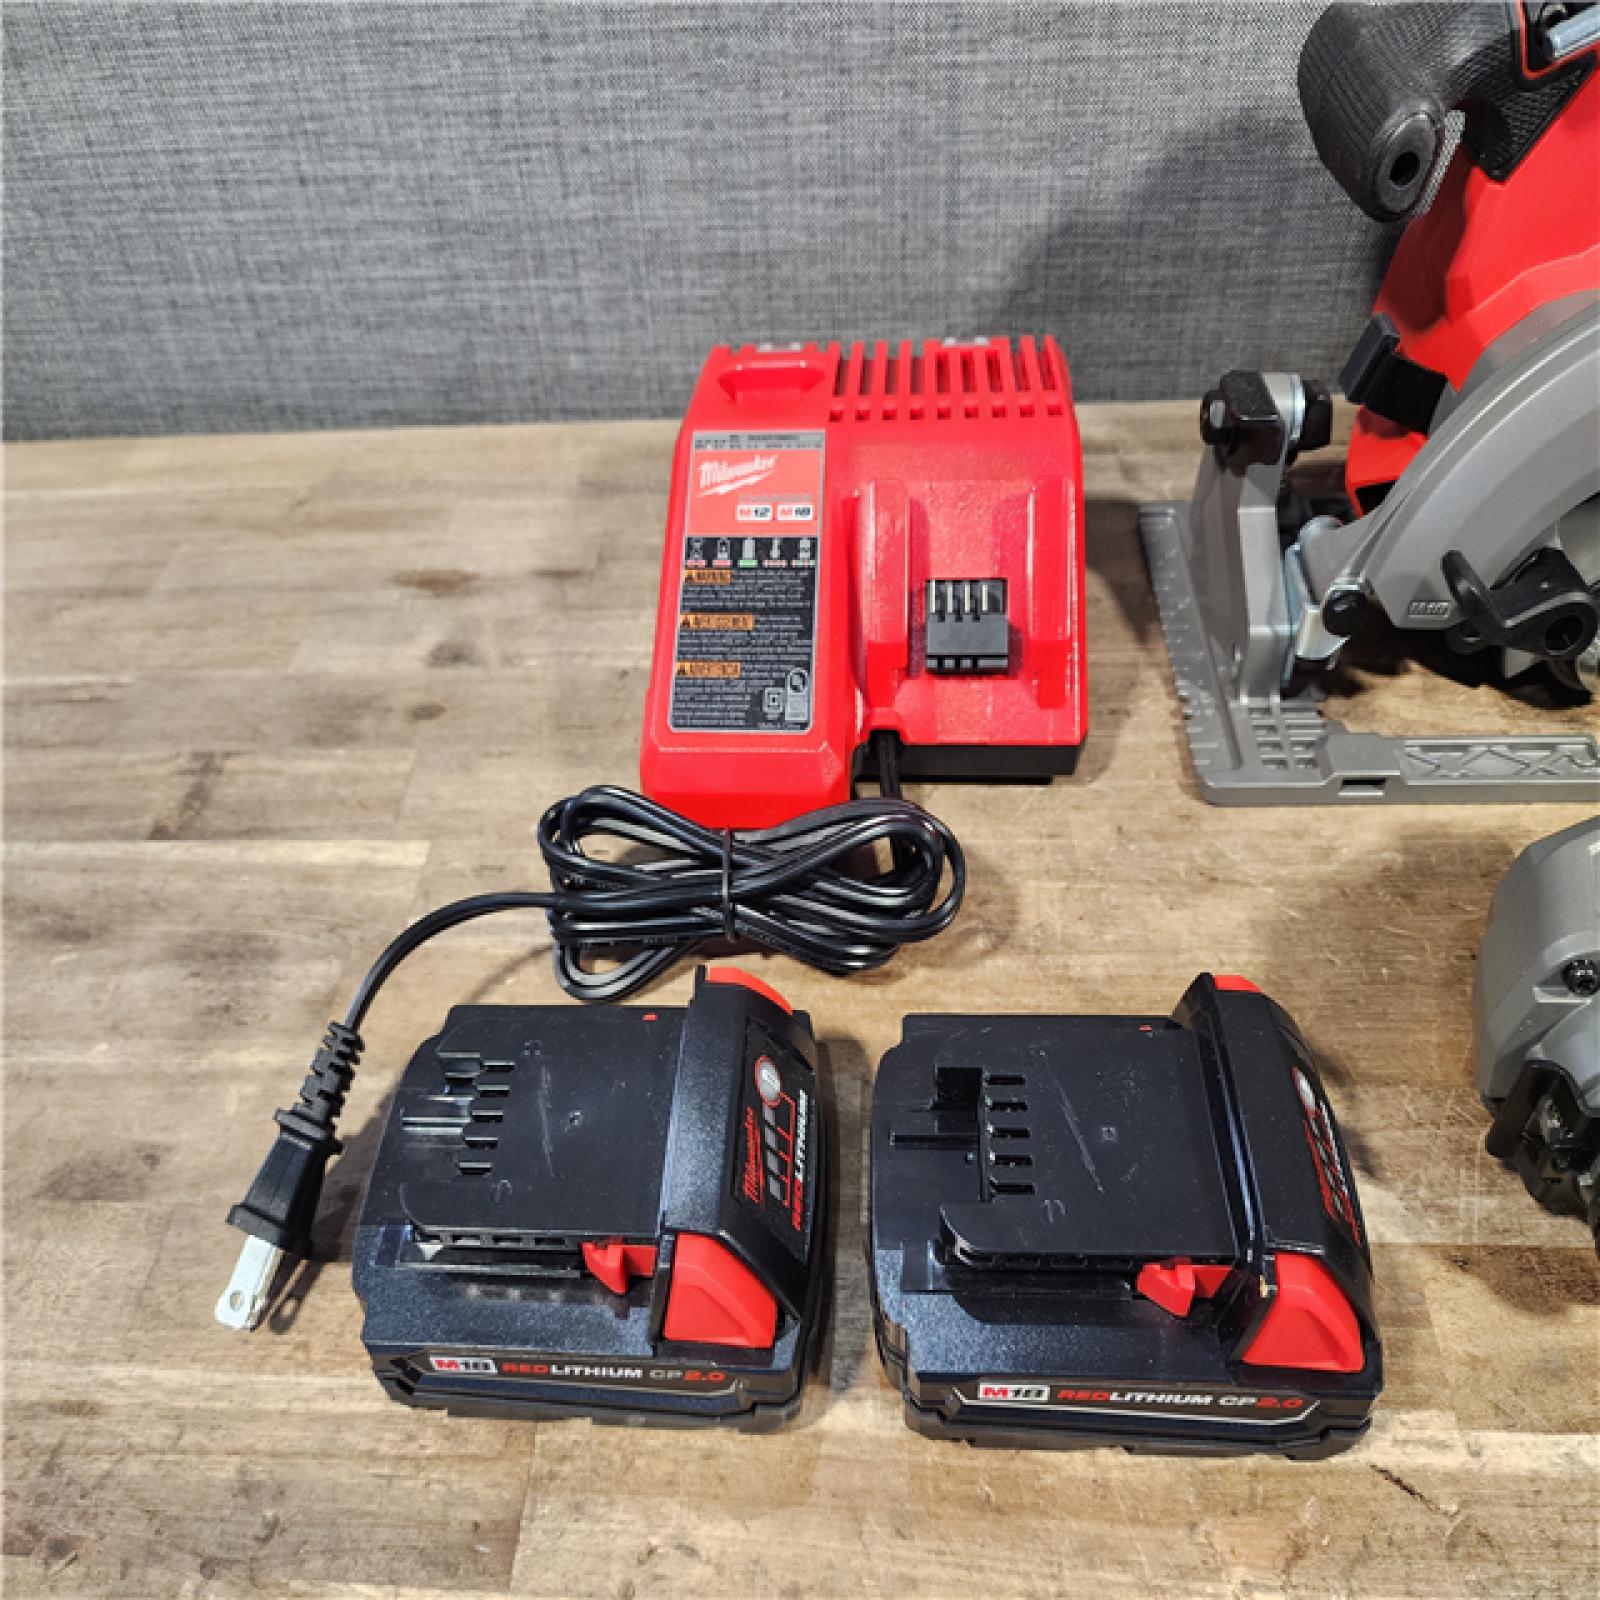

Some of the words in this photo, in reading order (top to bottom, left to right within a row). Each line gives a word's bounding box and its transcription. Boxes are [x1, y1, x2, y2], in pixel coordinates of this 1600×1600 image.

[433, 1358, 492, 1373] M18
[502, 1362, 643, 1379] REDLITHIUM
[982, 1386, 1045, 1399] M18
[1057, 1389, 1213, 1406] REDLITHIUM
